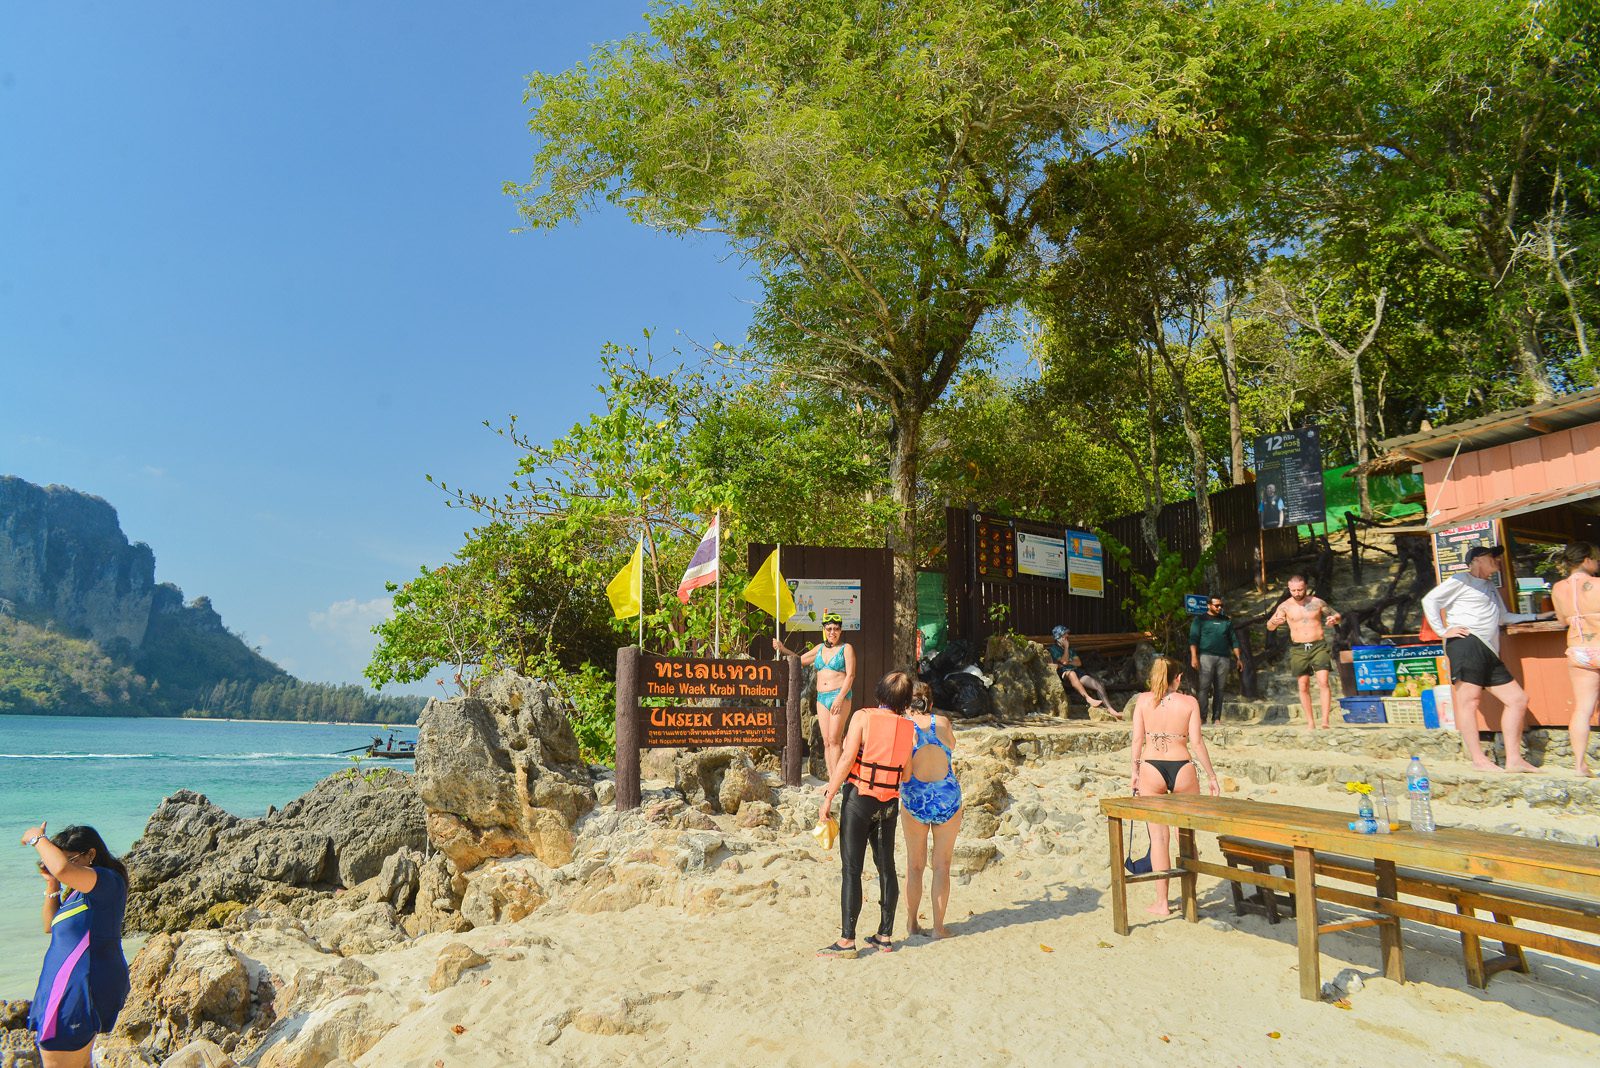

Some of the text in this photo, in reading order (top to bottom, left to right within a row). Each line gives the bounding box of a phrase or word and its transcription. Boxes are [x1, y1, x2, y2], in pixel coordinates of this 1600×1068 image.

[1265, 435, 1283, 451] 12
[655, 662, 772, 681] ทะเลแหวก
[648, 682, 778, 696] Thale Waek Krabi Thailand
[722, 712, 773, 726] KRABI
